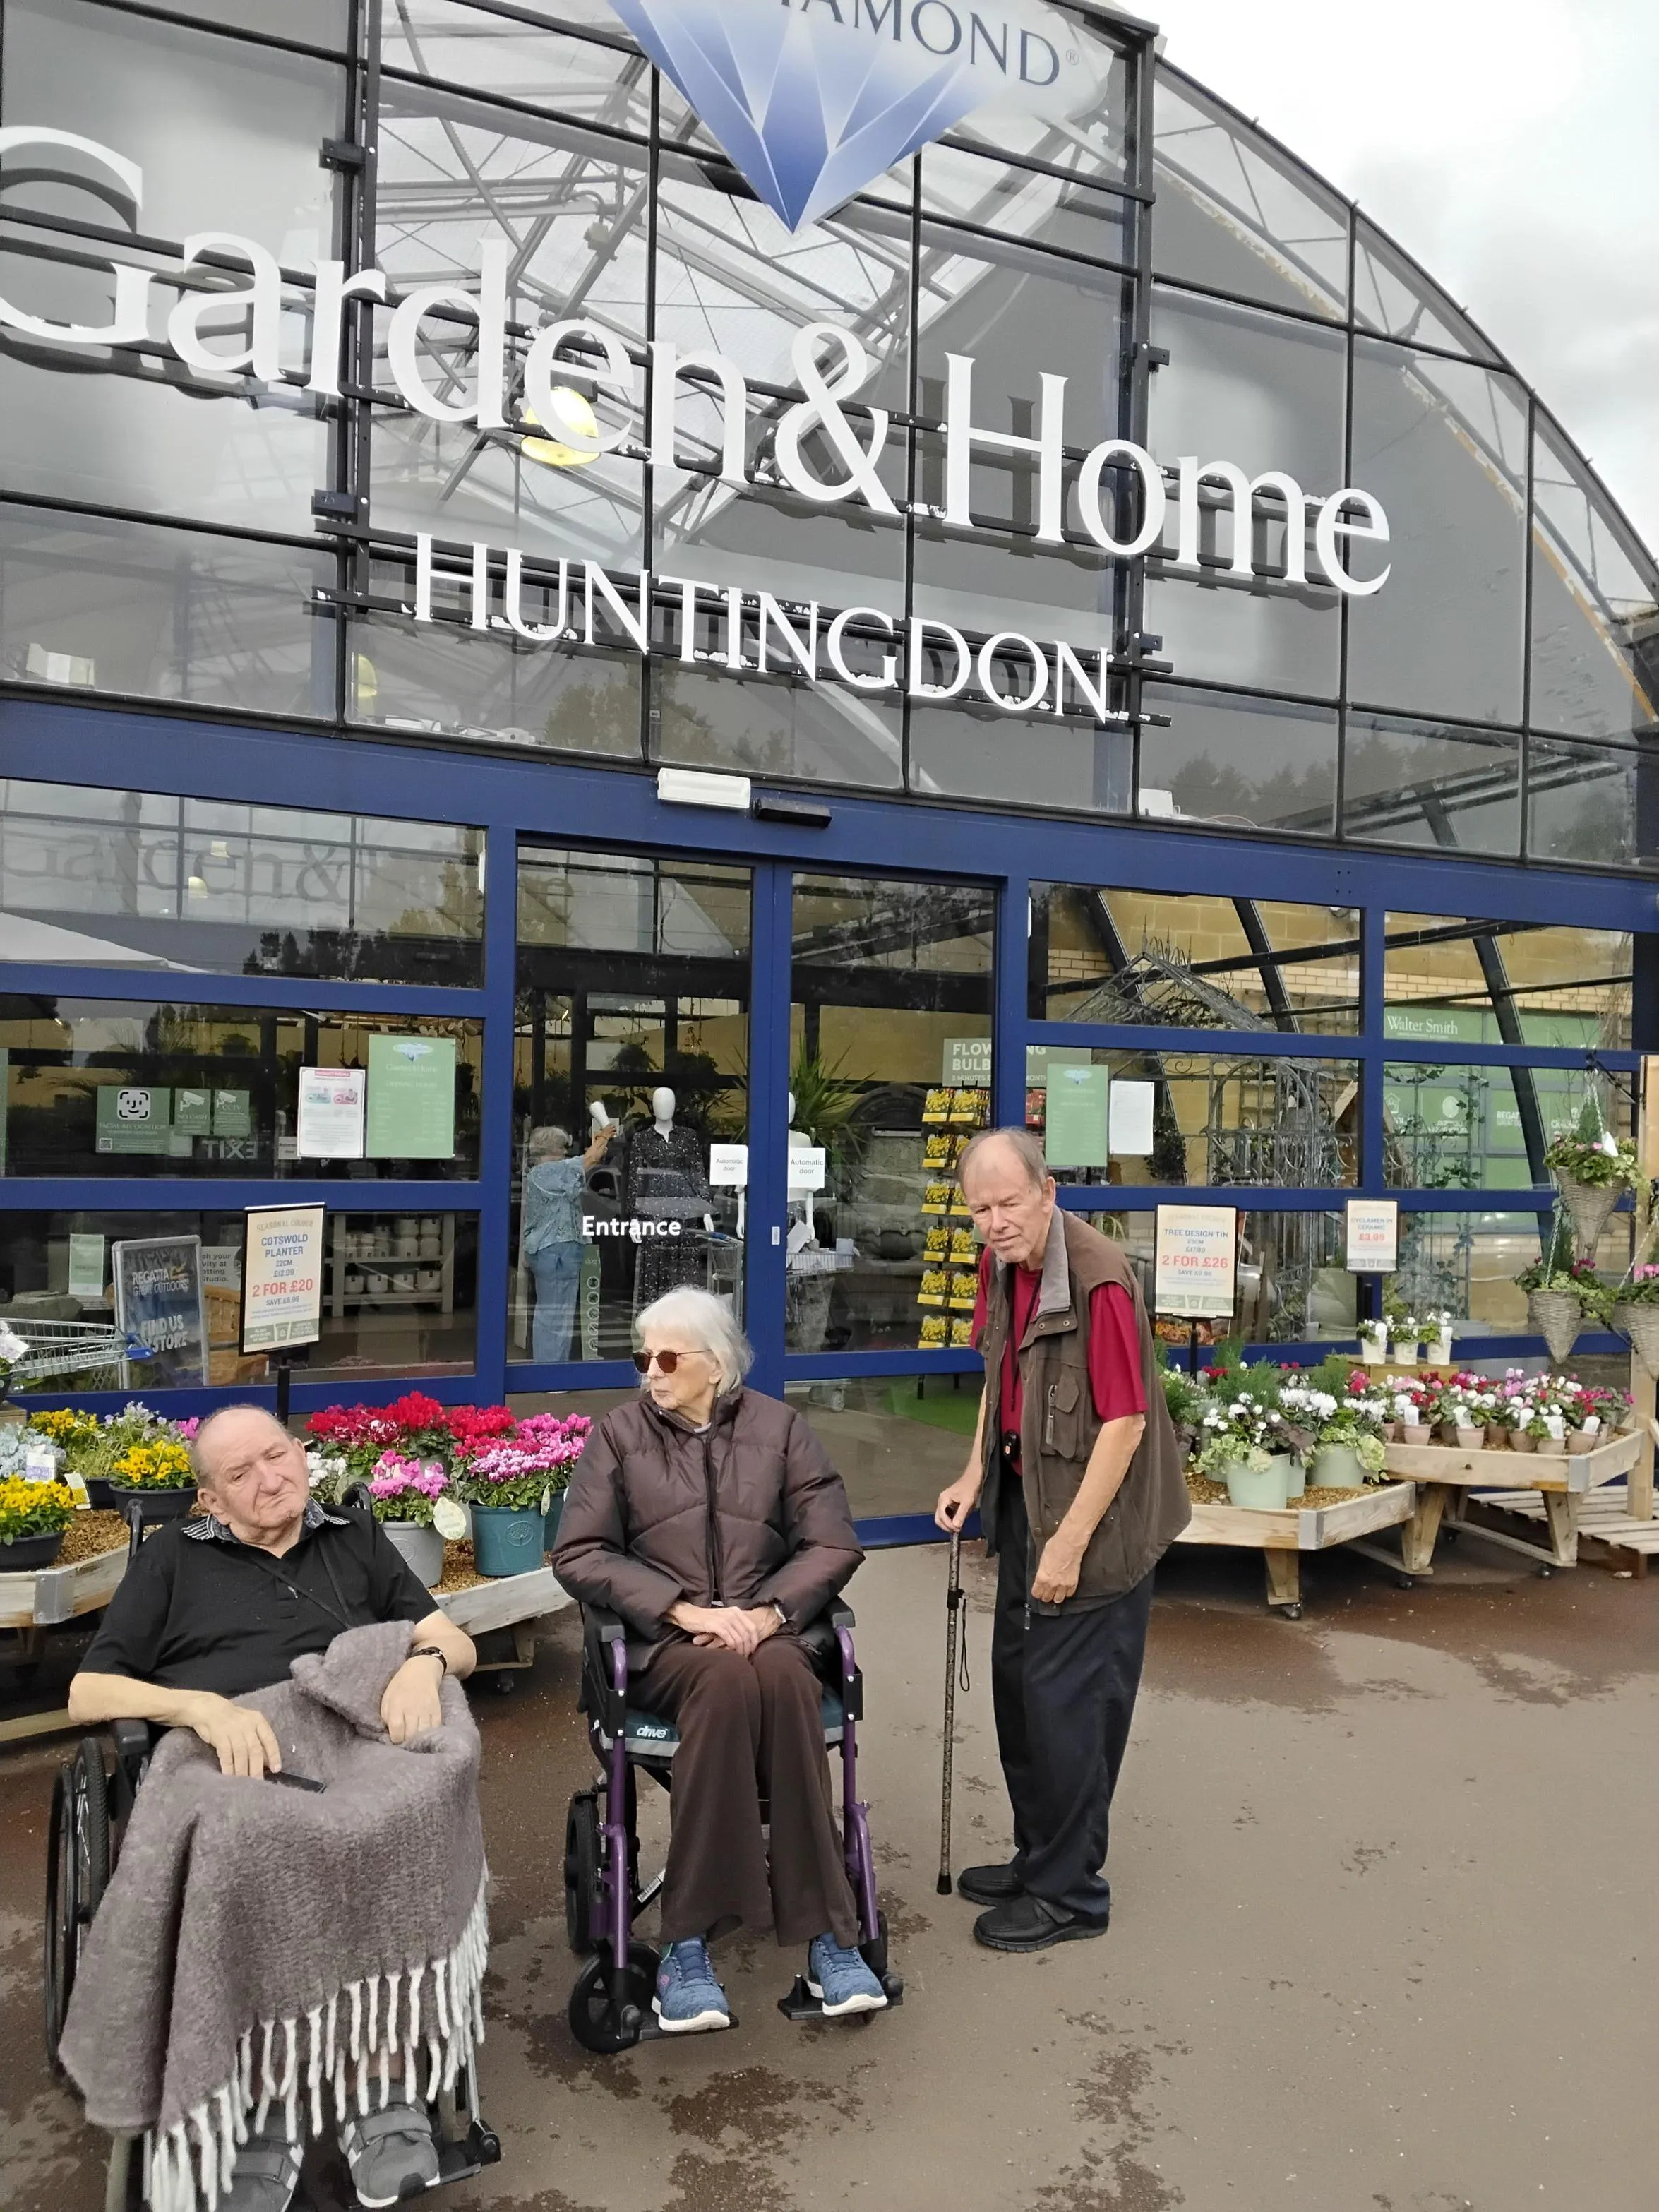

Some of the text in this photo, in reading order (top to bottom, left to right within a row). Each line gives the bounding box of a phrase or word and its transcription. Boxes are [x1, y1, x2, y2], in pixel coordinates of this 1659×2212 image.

[0, 125, 750, 485] Garden
[944, 352, 1391, 597] Home
[414, 532, 1110, 724] HUNTINGDON
[1386, 1015, 1458, 1034] Walter Smith
[953, 1058, 990, 1070] BULB
[1497, 1111, 1520, 1120] REGAT
[790, 1159, 824, 1167] Automatic
[582, 1215, 681, 1237] Entrance
[261, 1234, 309, 1247] COTSWOLD
[1185, 1229, 1213, 1238] DESIGN
[265, 1246, 304, 1257] PLANTER
[1162, 1255, 1228, 1269] 2 FOR £26
[132, 1269, 169, 1285] REGATTA
[253, 1278, 313, 1298] 2 FOR £20
[265, 1298, 281, 1306] SAVE
[142, 1314, 184, 1336] FIND US
[152, 1330, 188, 1353] STORE
[636, 1726, 667, 1738] drive
